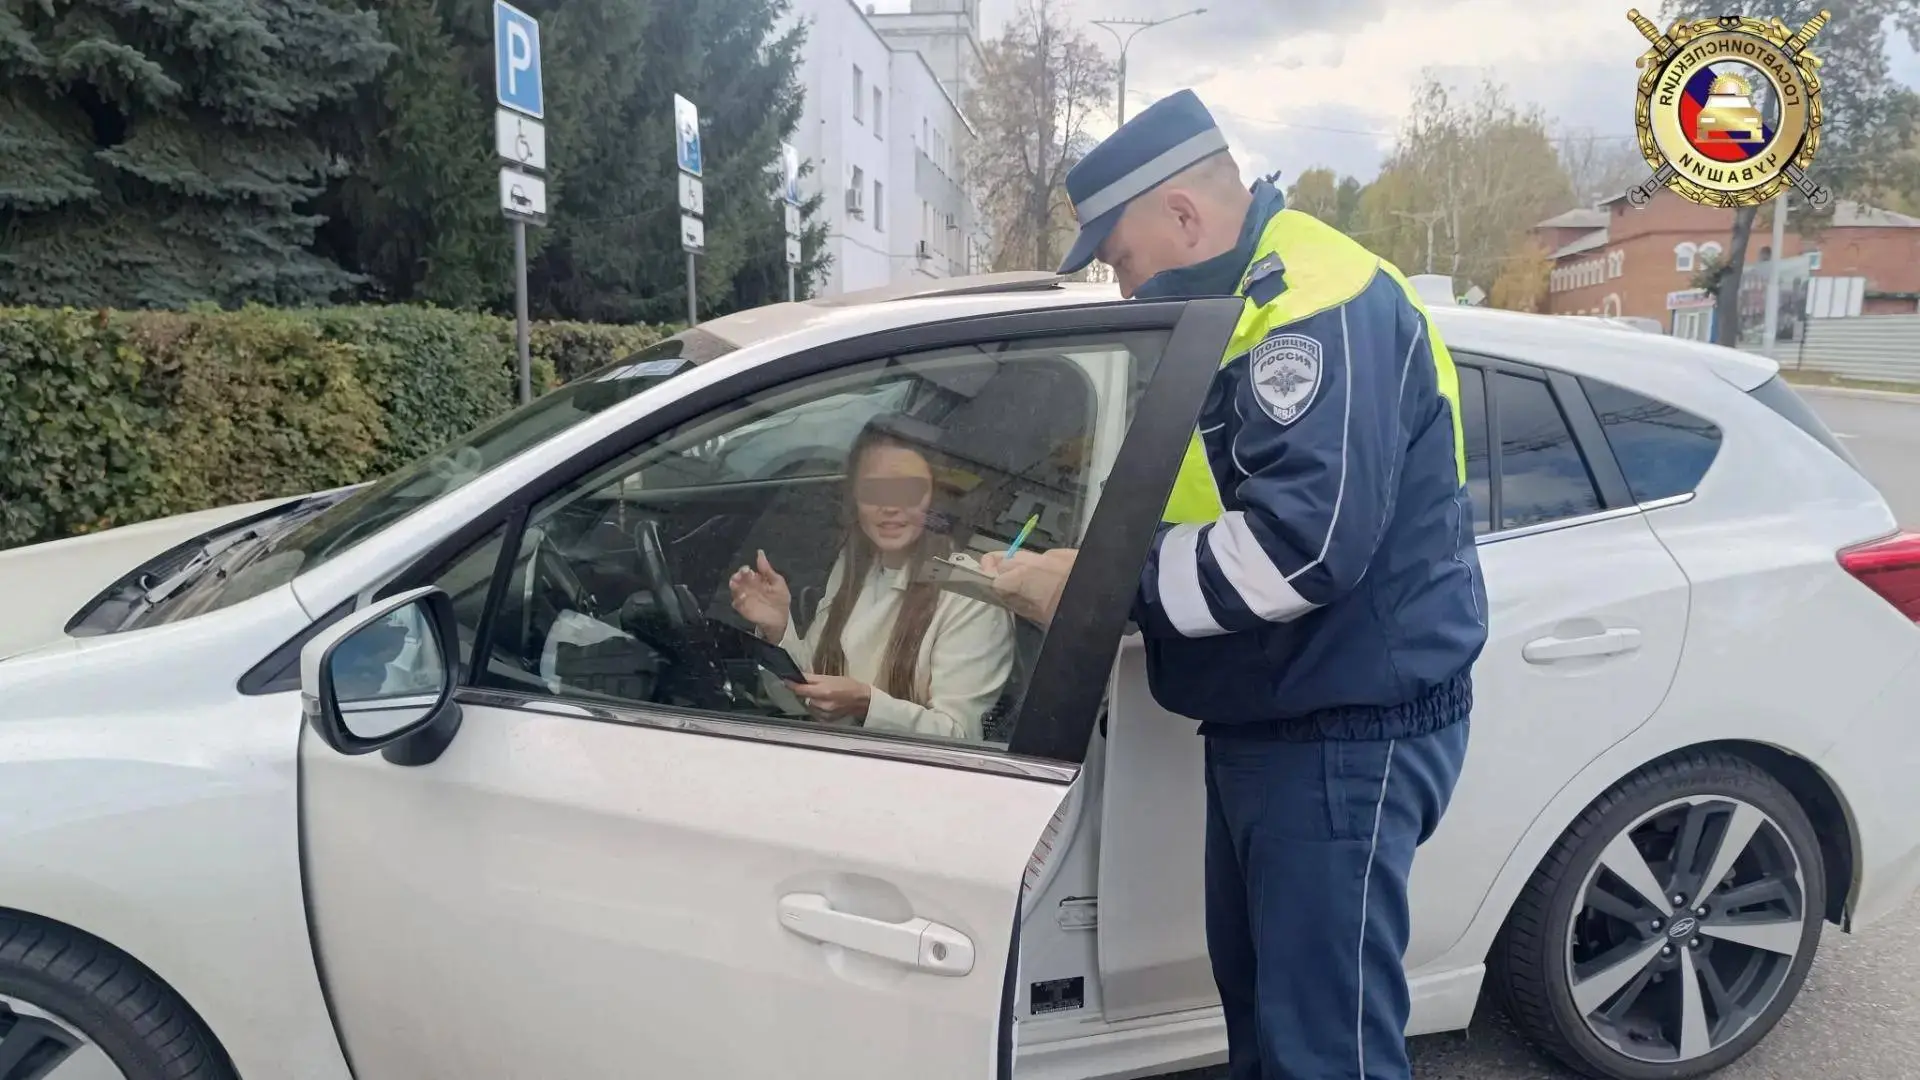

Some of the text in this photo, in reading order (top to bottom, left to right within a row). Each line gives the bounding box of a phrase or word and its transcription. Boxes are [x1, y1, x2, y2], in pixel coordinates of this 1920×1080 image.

[507, 20, 532, 96] P
[1255, 338, 1316, 359] ПОЛИЦИЯ
[1260, 352, 1312, 373] РОССИЯ
[1273, 405, 1297, 420] МВД
